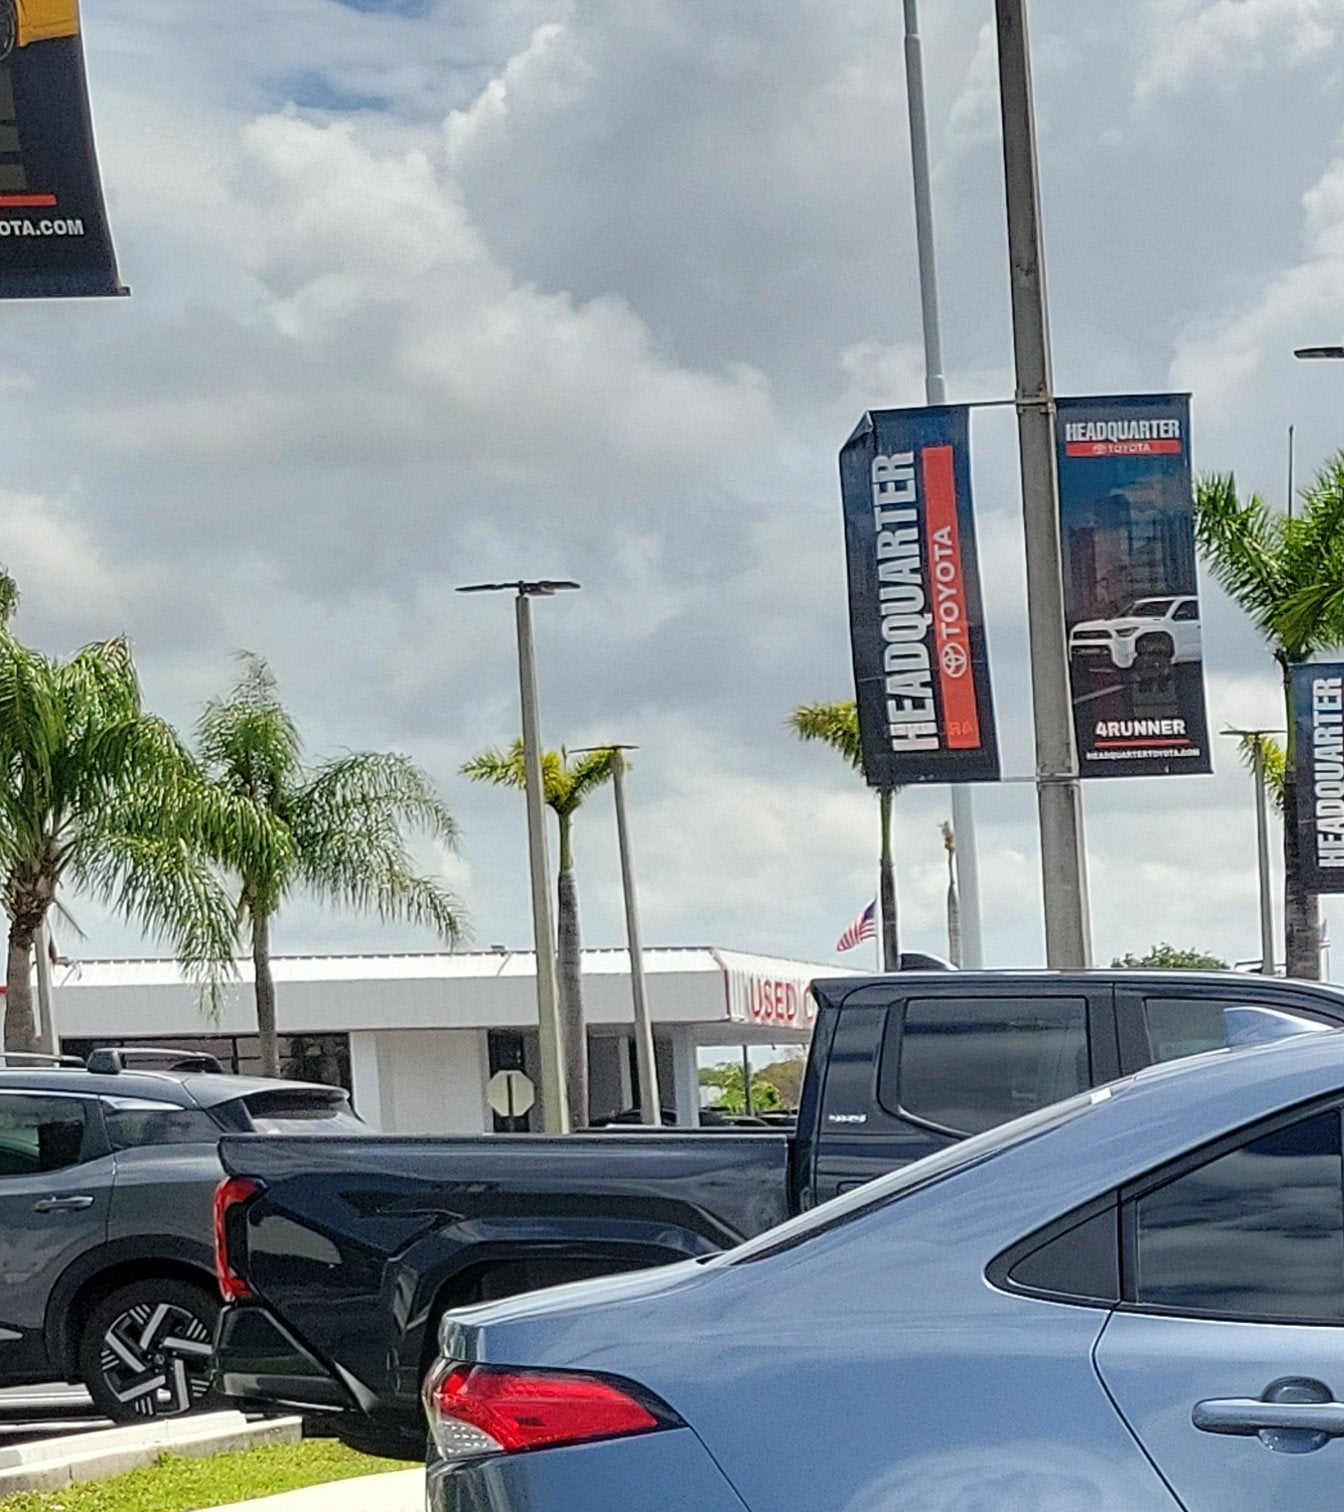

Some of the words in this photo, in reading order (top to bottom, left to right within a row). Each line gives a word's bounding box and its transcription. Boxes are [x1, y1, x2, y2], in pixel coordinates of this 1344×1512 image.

[1065, 420, 1180, 442] HEADQUARTER
[871, 450, 941, 752] HEADQUARTER
[932, 525, 961, 640] TOYOTA
[1095, 719, 1187, 738] 4RUNNER
[750, 978, 797, 1021] USED
